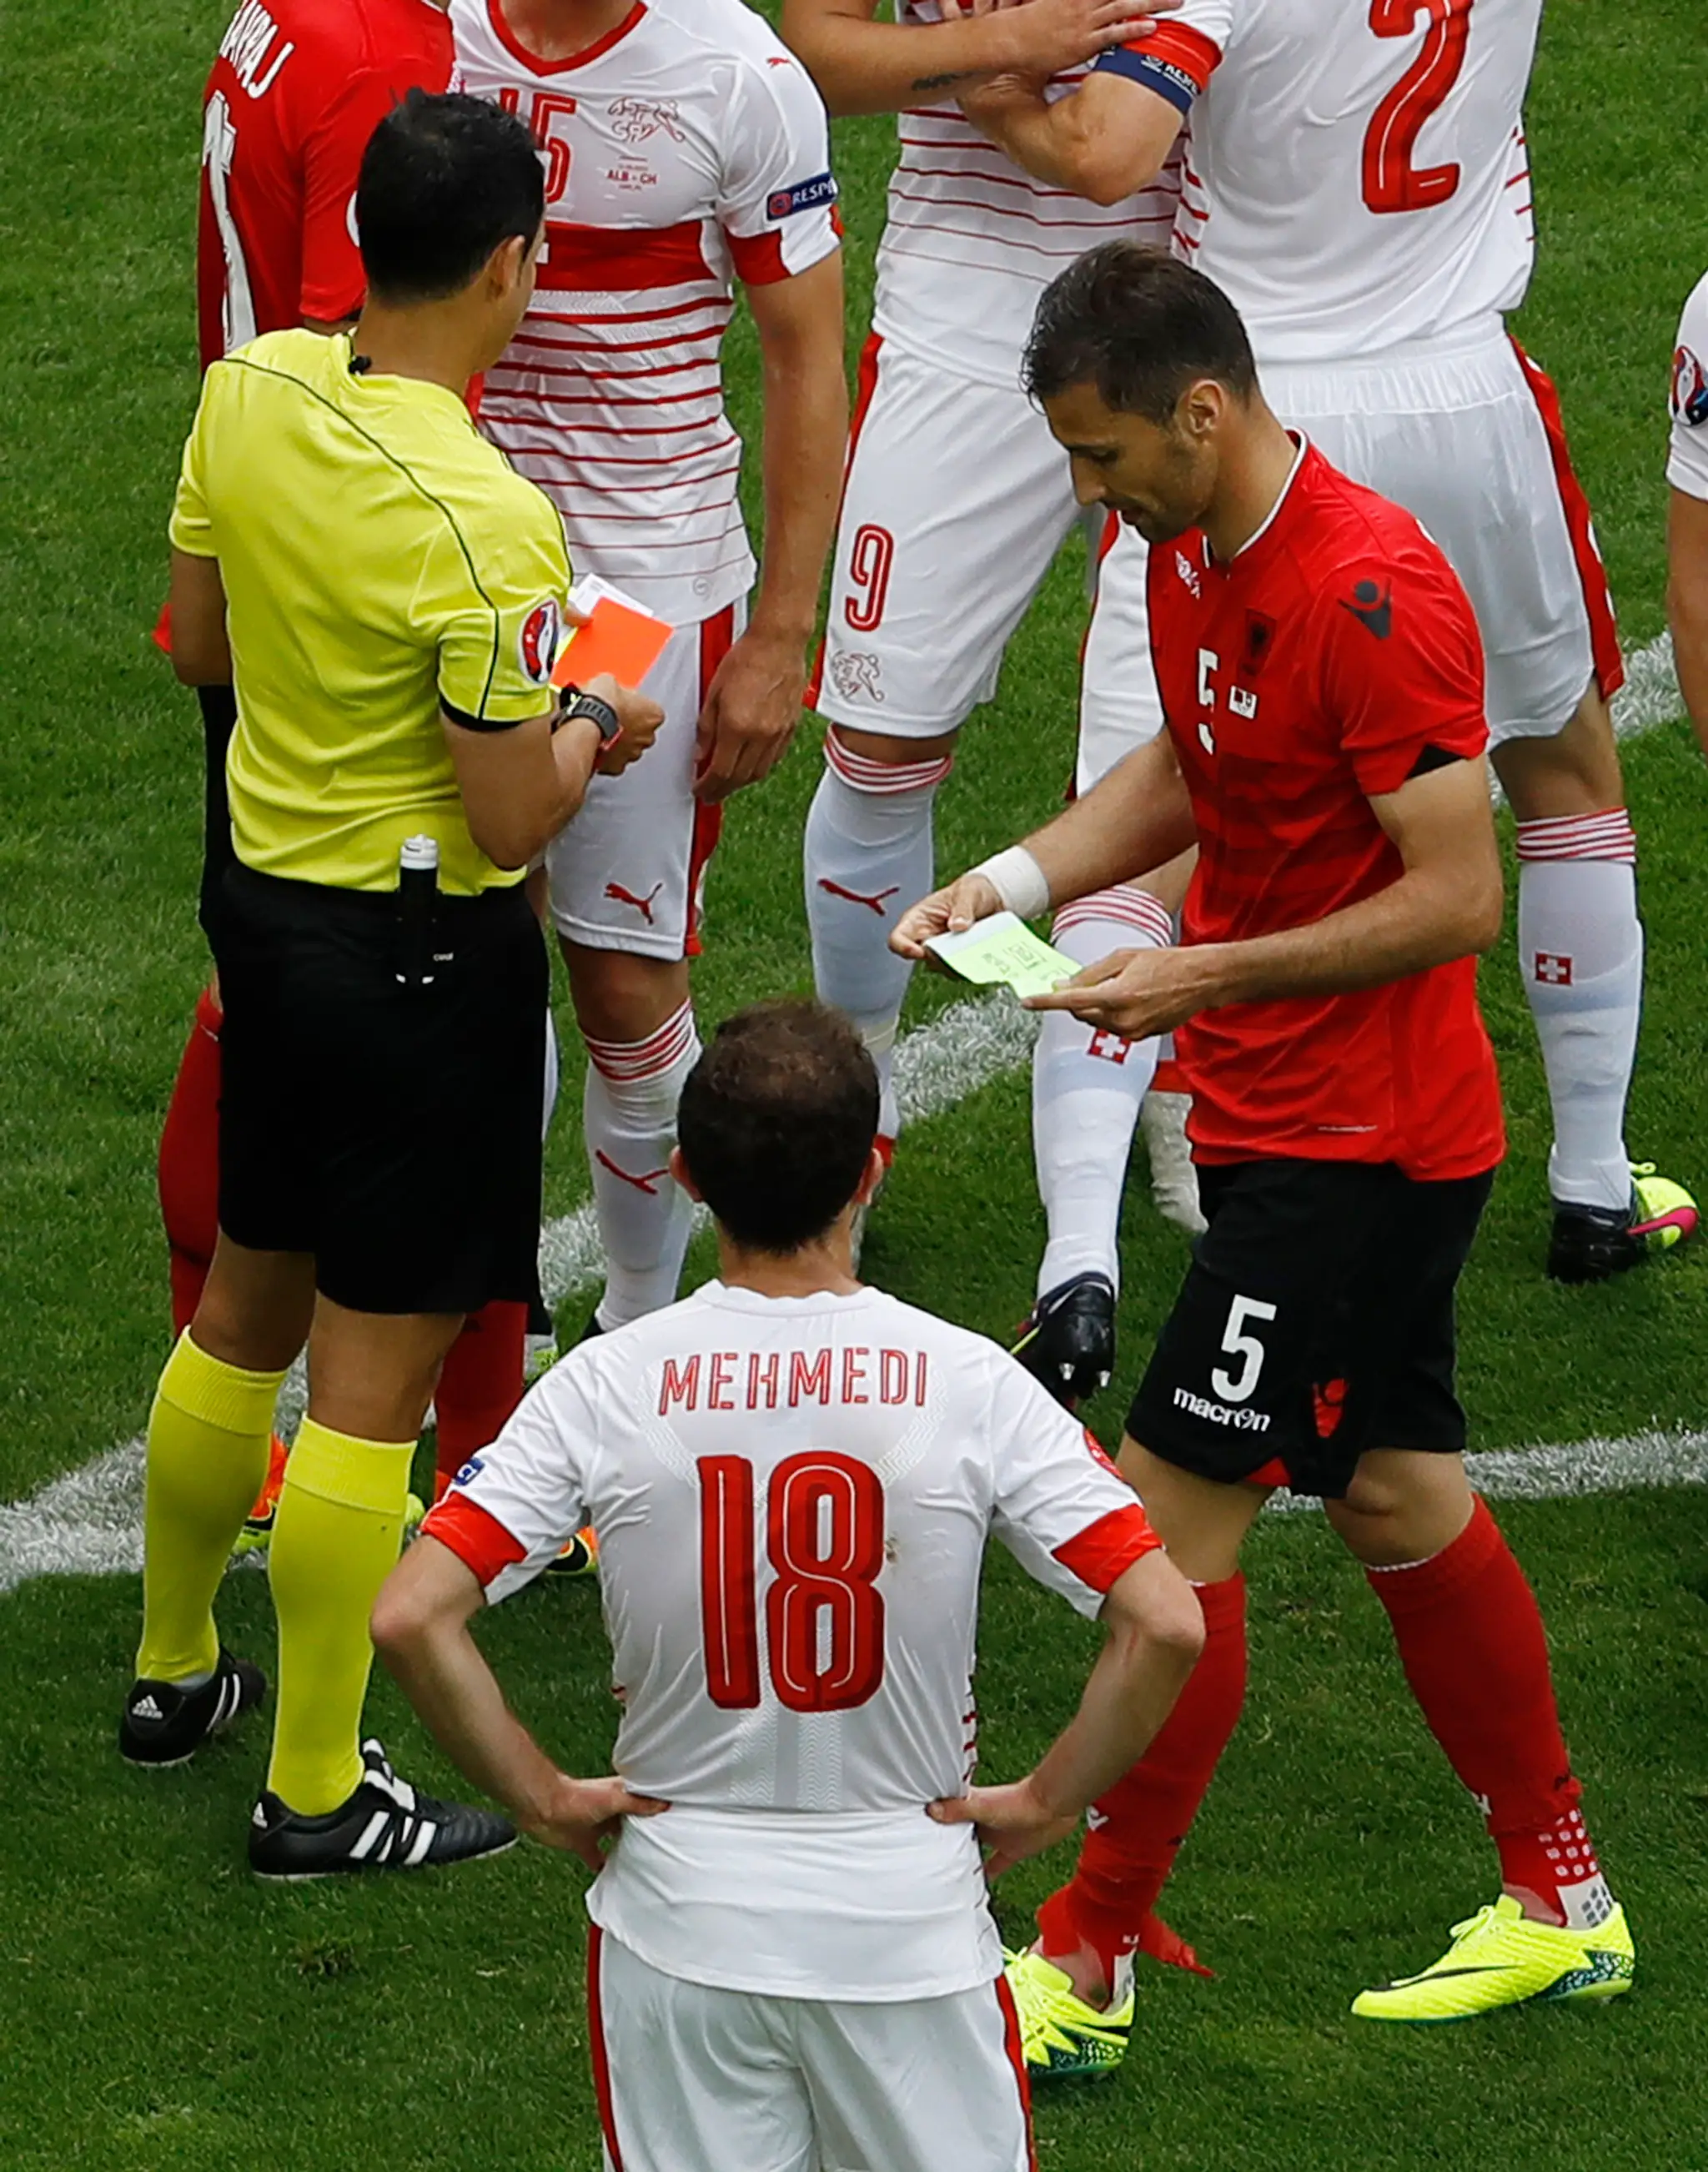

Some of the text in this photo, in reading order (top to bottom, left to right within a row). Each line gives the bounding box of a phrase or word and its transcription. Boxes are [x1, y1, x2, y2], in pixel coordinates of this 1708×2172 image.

[1363, 0, 1474, 214] 2
[845, 523, 894, 631] 9
[658, 1347, 927, 1416] MEHMEDI
[1211, 1294, 1277, 1402] 5
[1173, 1387, 1271, 1431] macron
[696, 1450, 886, 1712] 18
